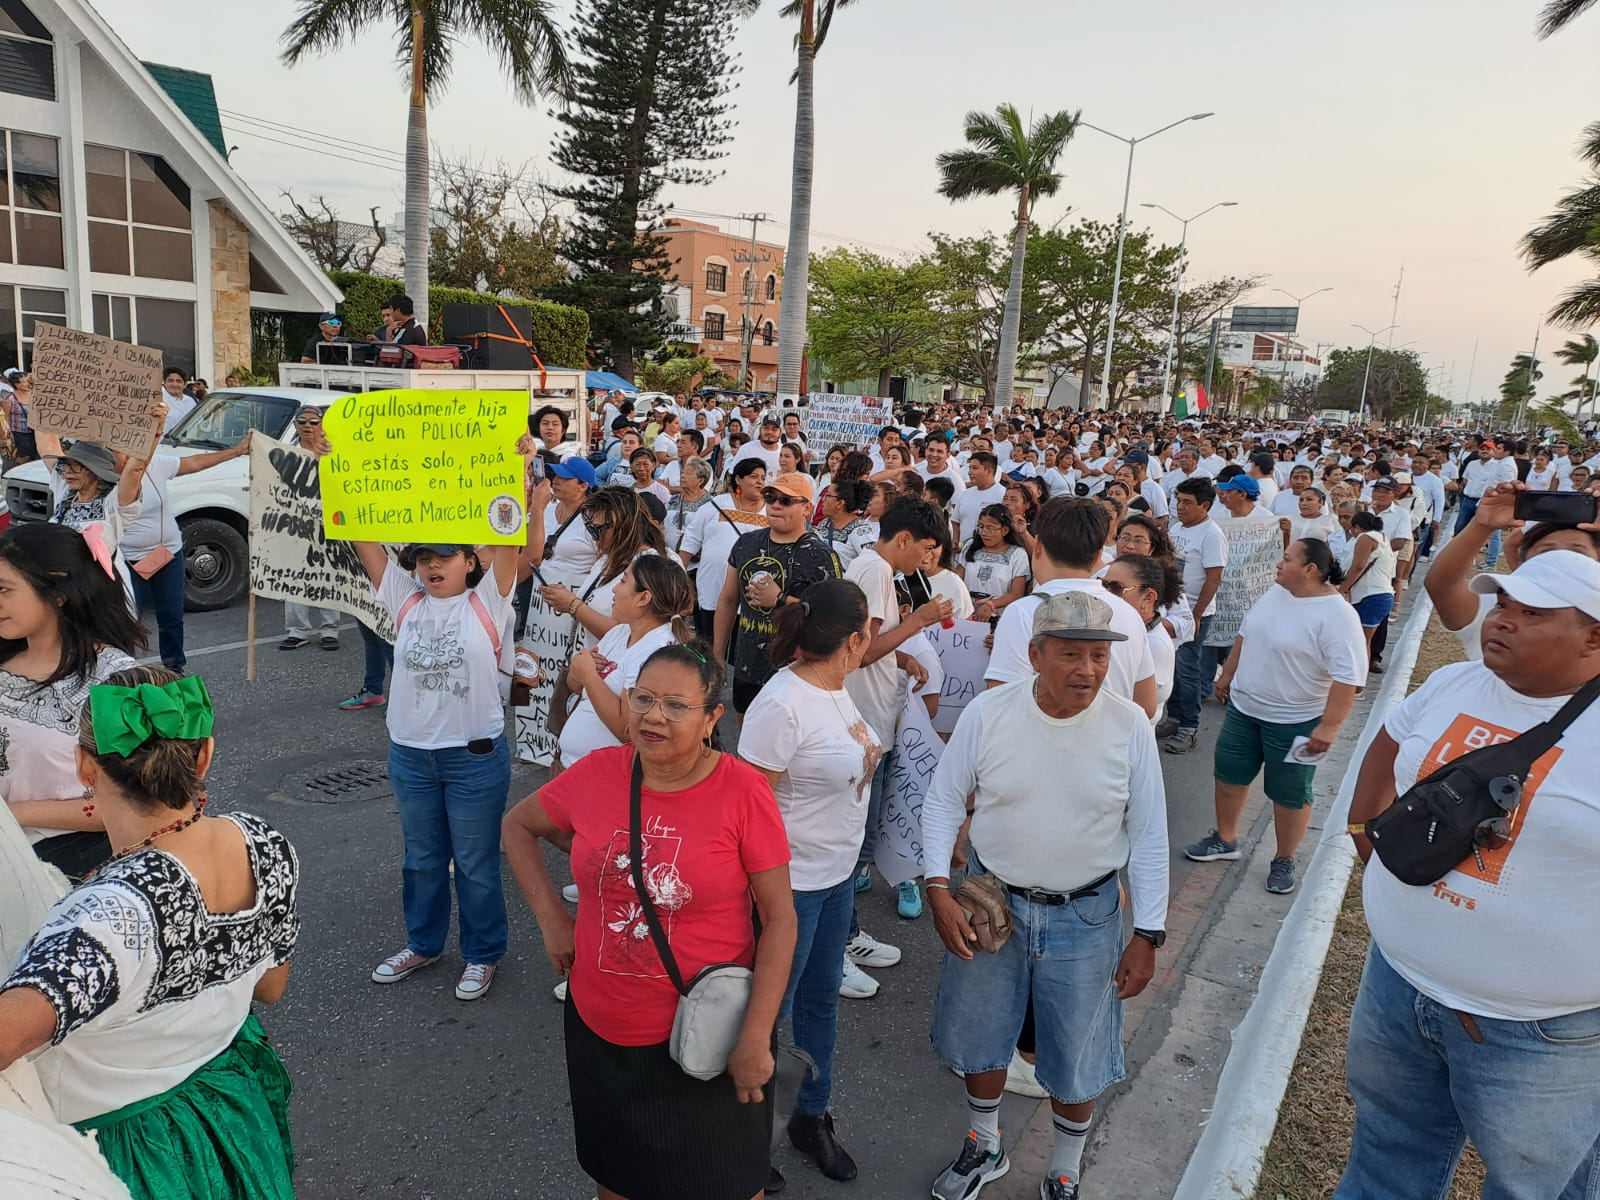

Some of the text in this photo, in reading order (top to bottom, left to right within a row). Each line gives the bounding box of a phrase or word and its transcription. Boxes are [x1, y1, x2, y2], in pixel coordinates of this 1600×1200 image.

[112, 344, 119, 360] A
[34, 383, 76, 399] FUERA
[32, 394, 80, 412] PUEBLO
[87, 404, 115, 420] BUENO
[126, 414, 153, 430] SABIO
[343, 396, 508, 428] Orgullosamente hija
[39, 408, 146, 449] PONE Y QUITA
[353, 417, 483, 442] de un POLICÍA
[331, 447, 505, 474] No estás solo, papá
[343, 472, 516, 494] estamos en tu lucha
[352, 502, 413, 525] #Fuera
[420, 498, 483, 522] Marcela
[251, 577, 264, 590] No
[953, 632, 972, 649] DE
[886, 794, 914, 839] lejos
